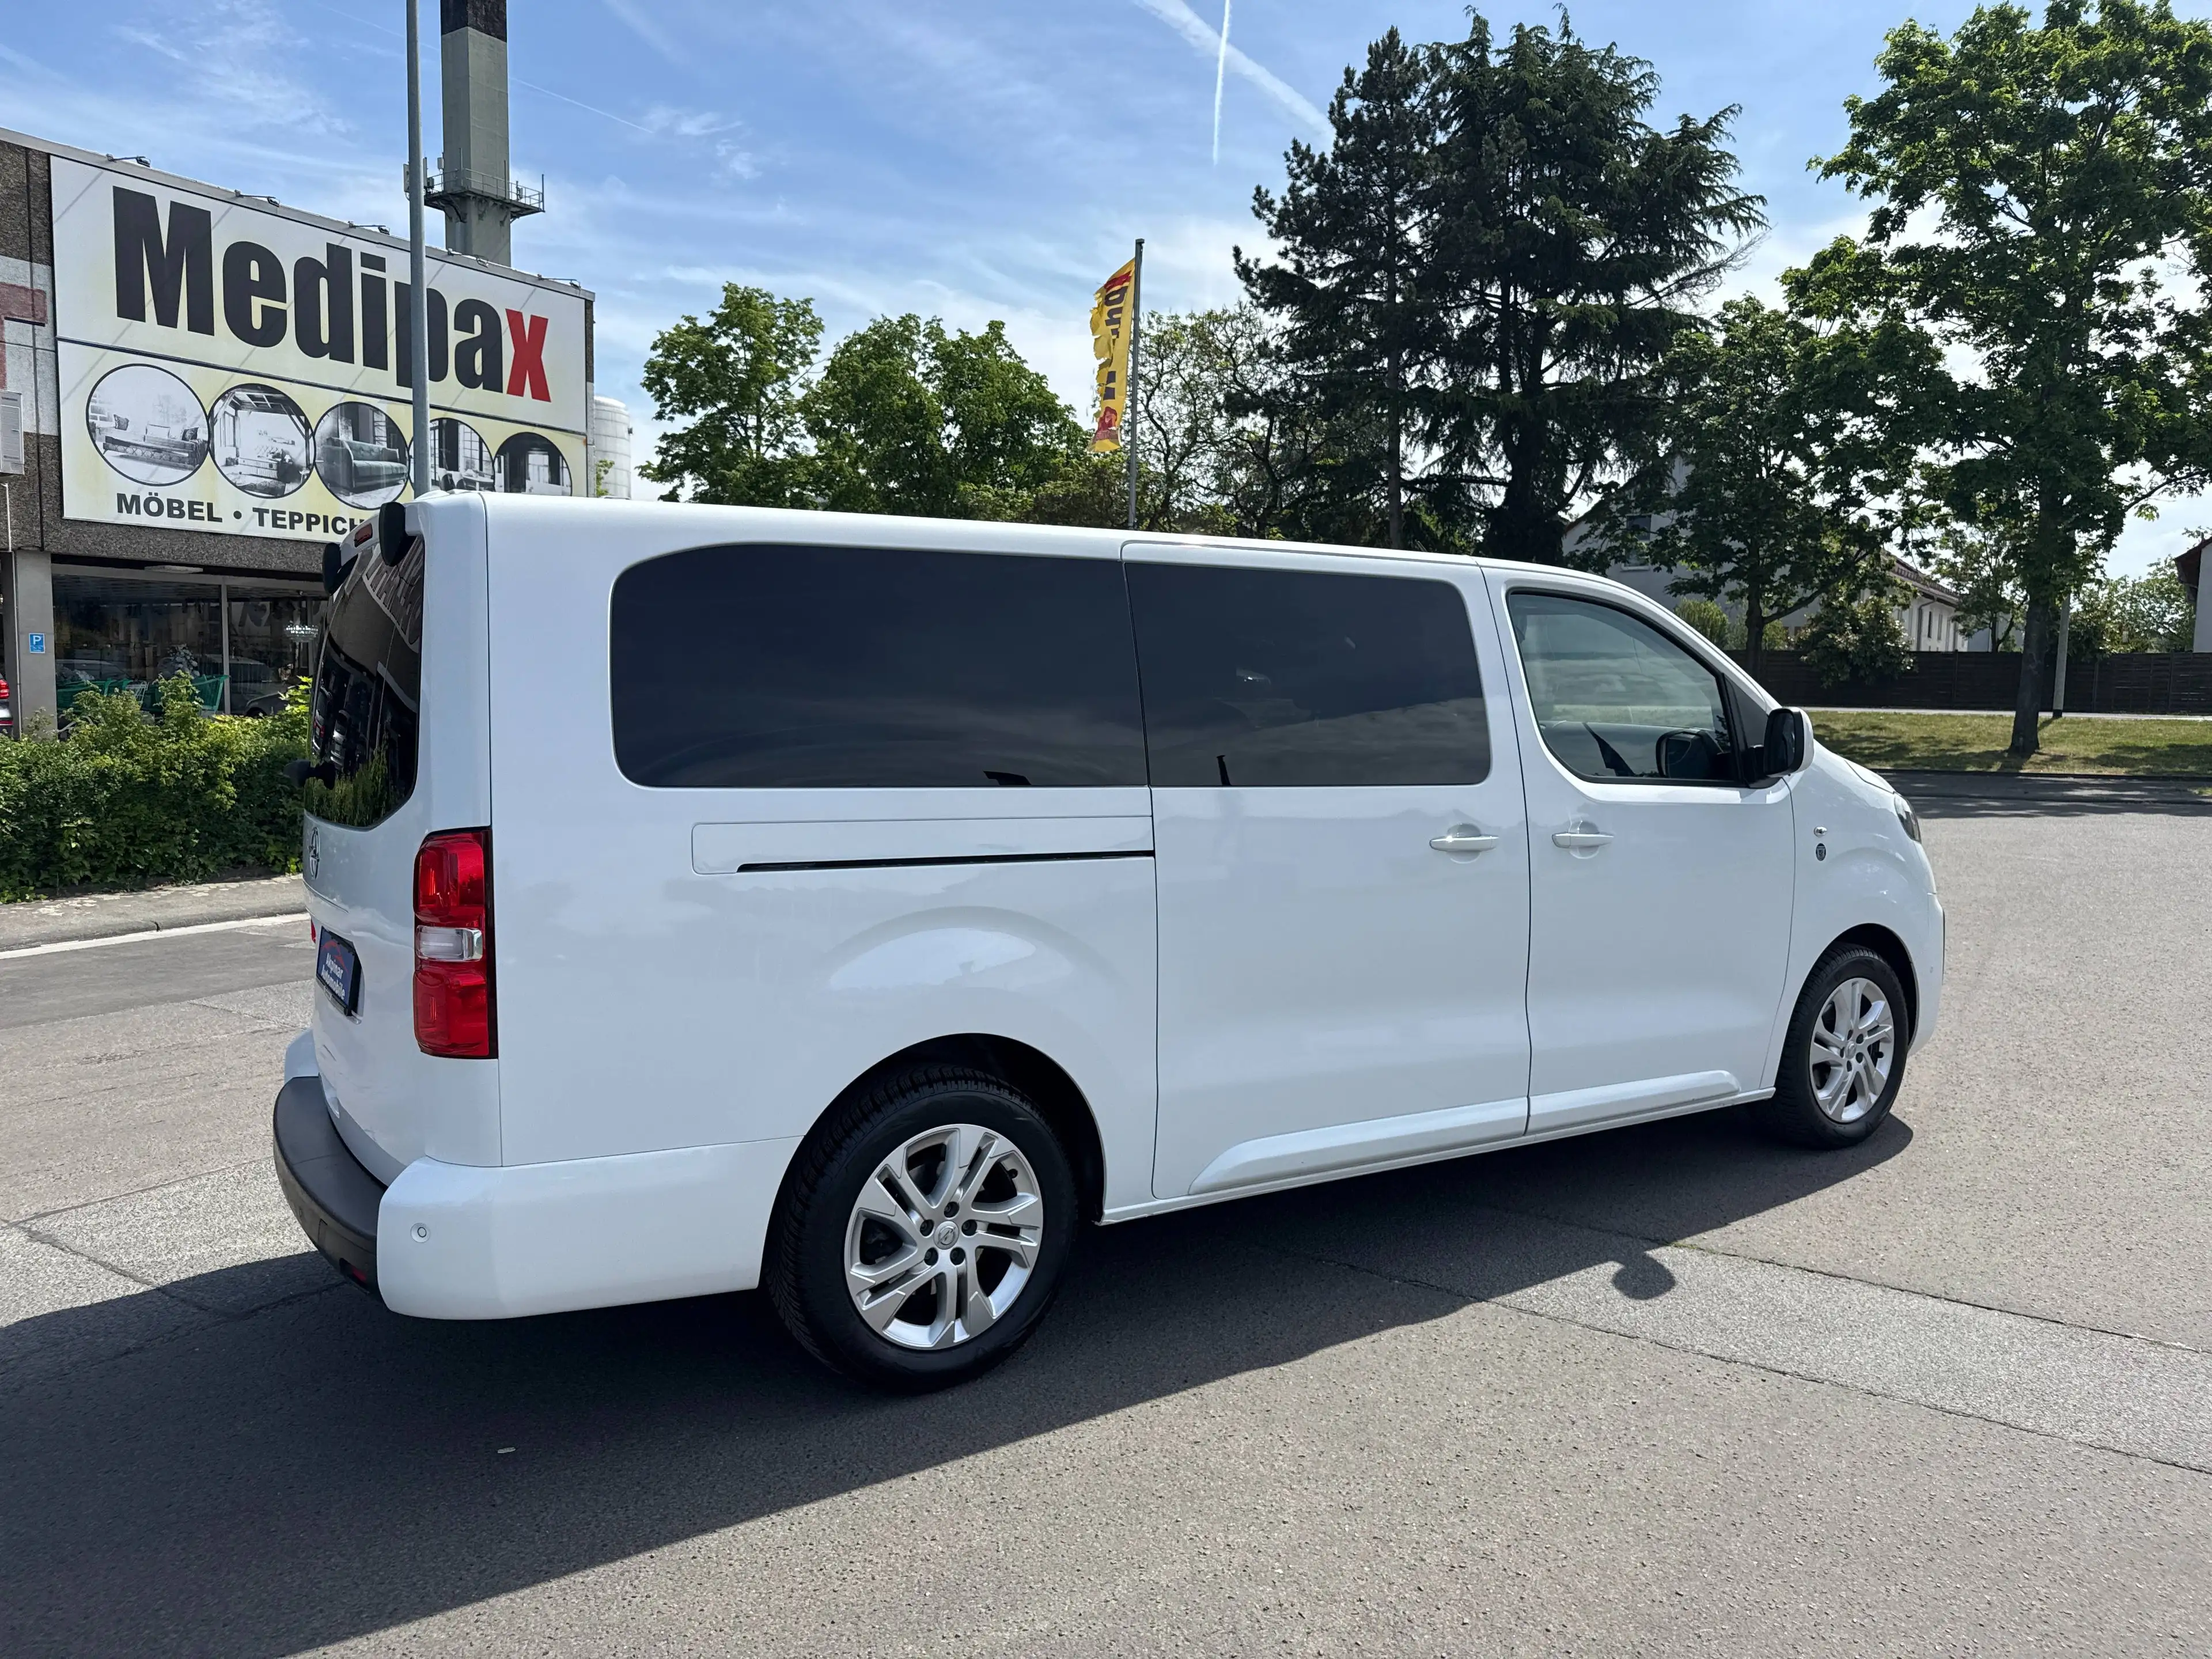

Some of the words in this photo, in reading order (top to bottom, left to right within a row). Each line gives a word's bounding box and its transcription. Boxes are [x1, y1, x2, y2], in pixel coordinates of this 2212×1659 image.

[113, 185, 551, 403] Medipax
[116, 492, 223, 522] MÖBEL
[33, 635, 41, 645] P
[321, 964, 345, 1000] Automobile
